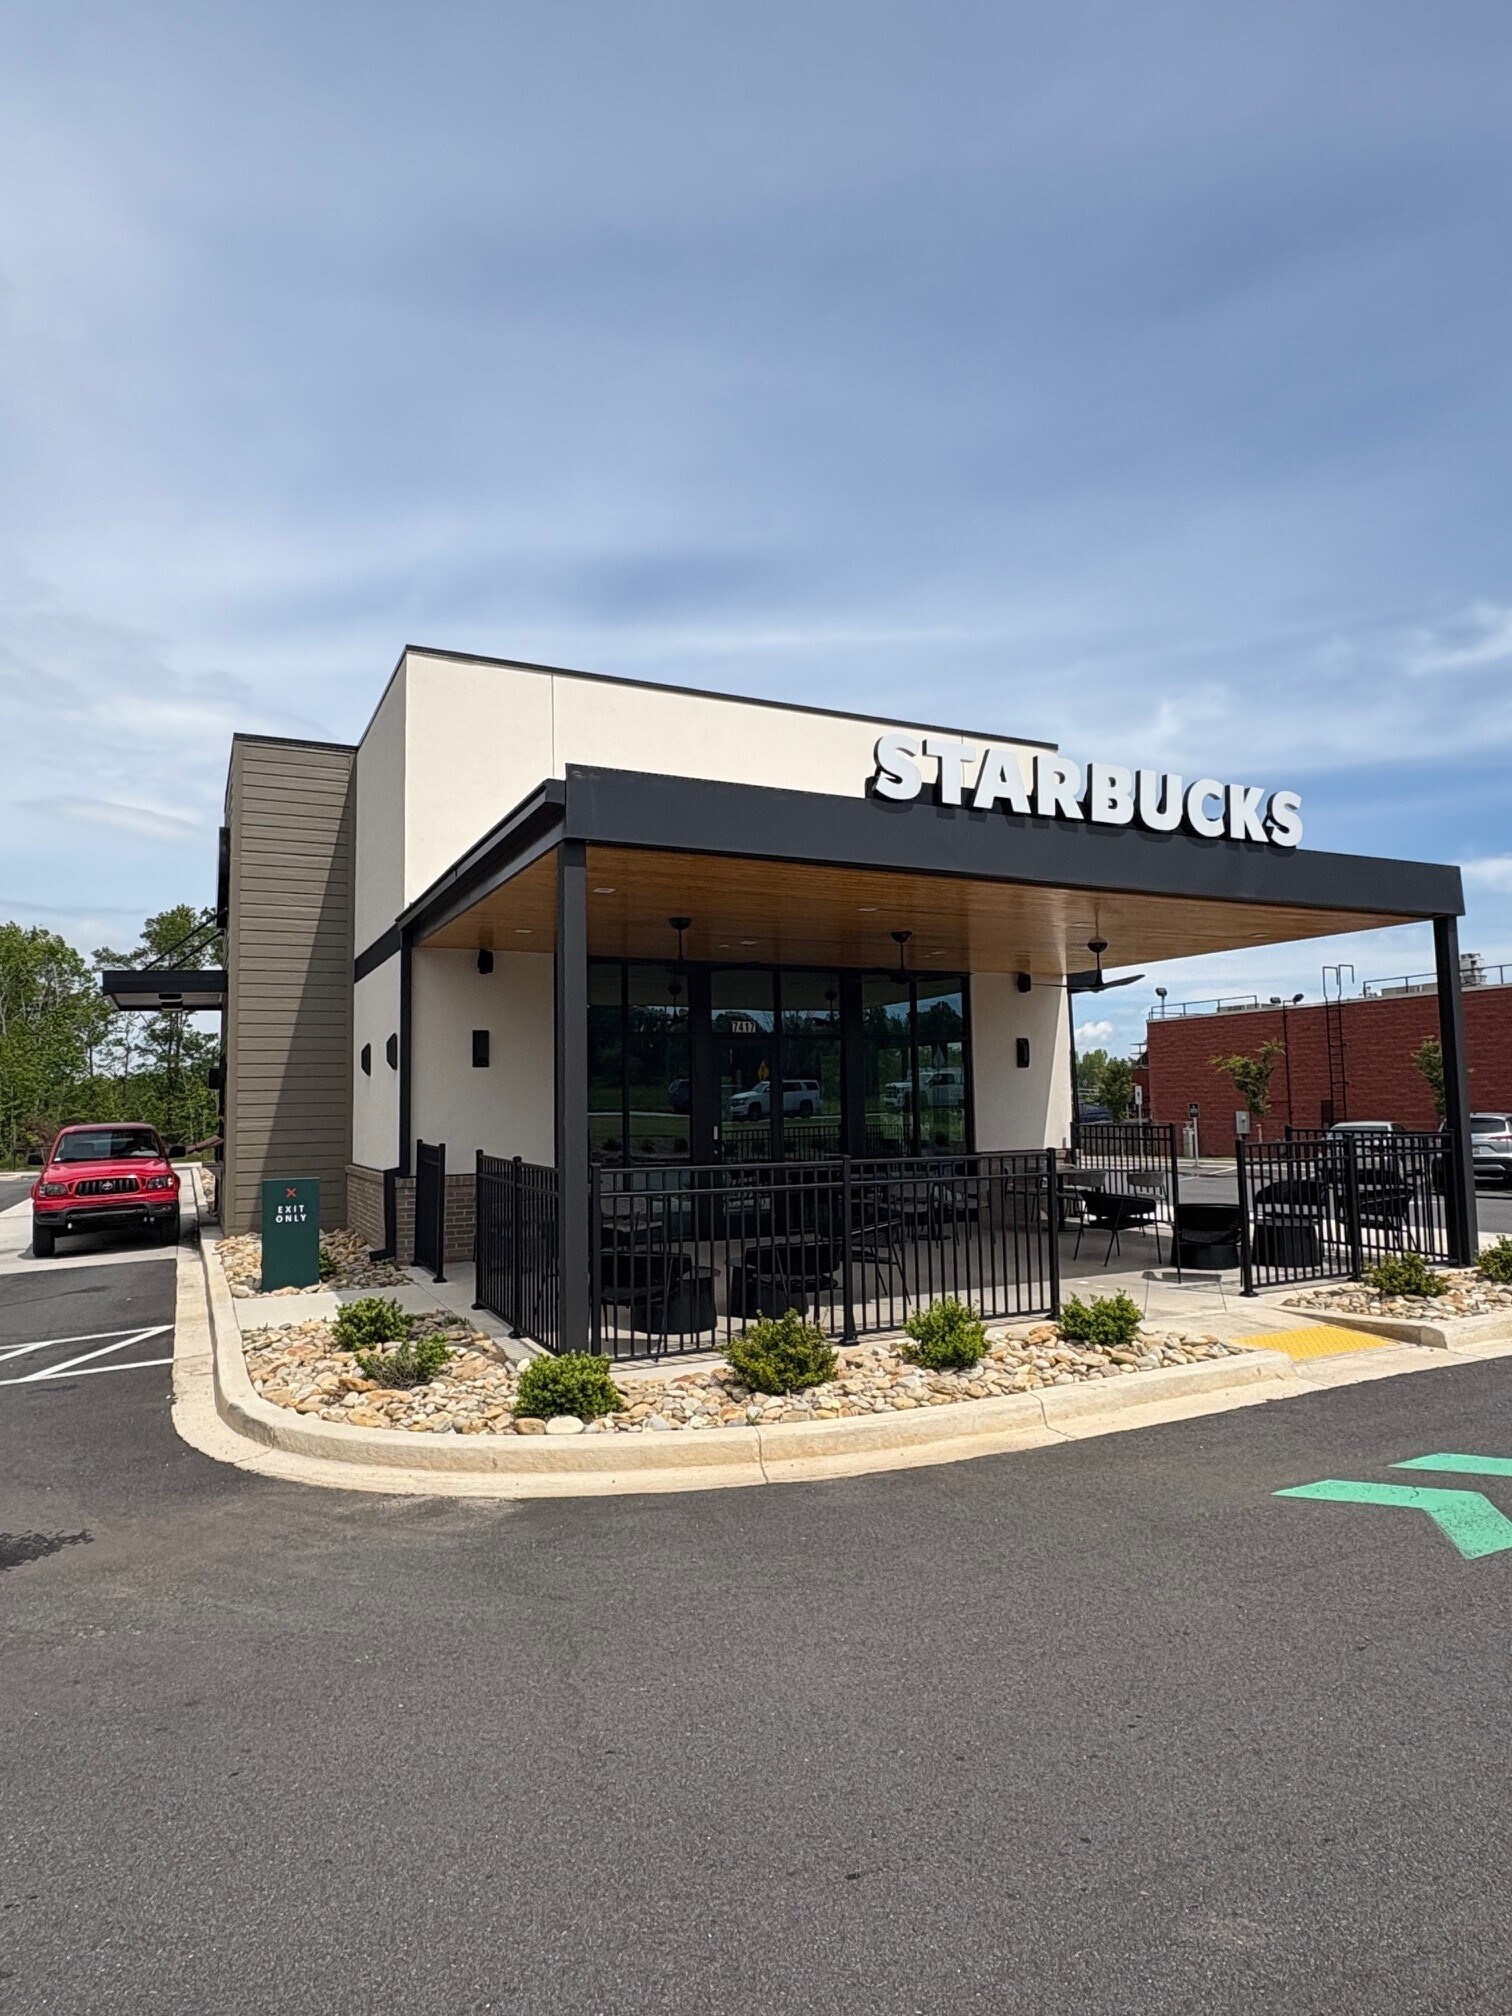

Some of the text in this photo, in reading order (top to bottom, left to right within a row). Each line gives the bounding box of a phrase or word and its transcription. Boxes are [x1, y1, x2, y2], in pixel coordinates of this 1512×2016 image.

[874, 733, 1304, 848] STARBUCKS
[277, 1205, 305, 1214] EXIT
[275, 1213, 307, 1223] ONLY
